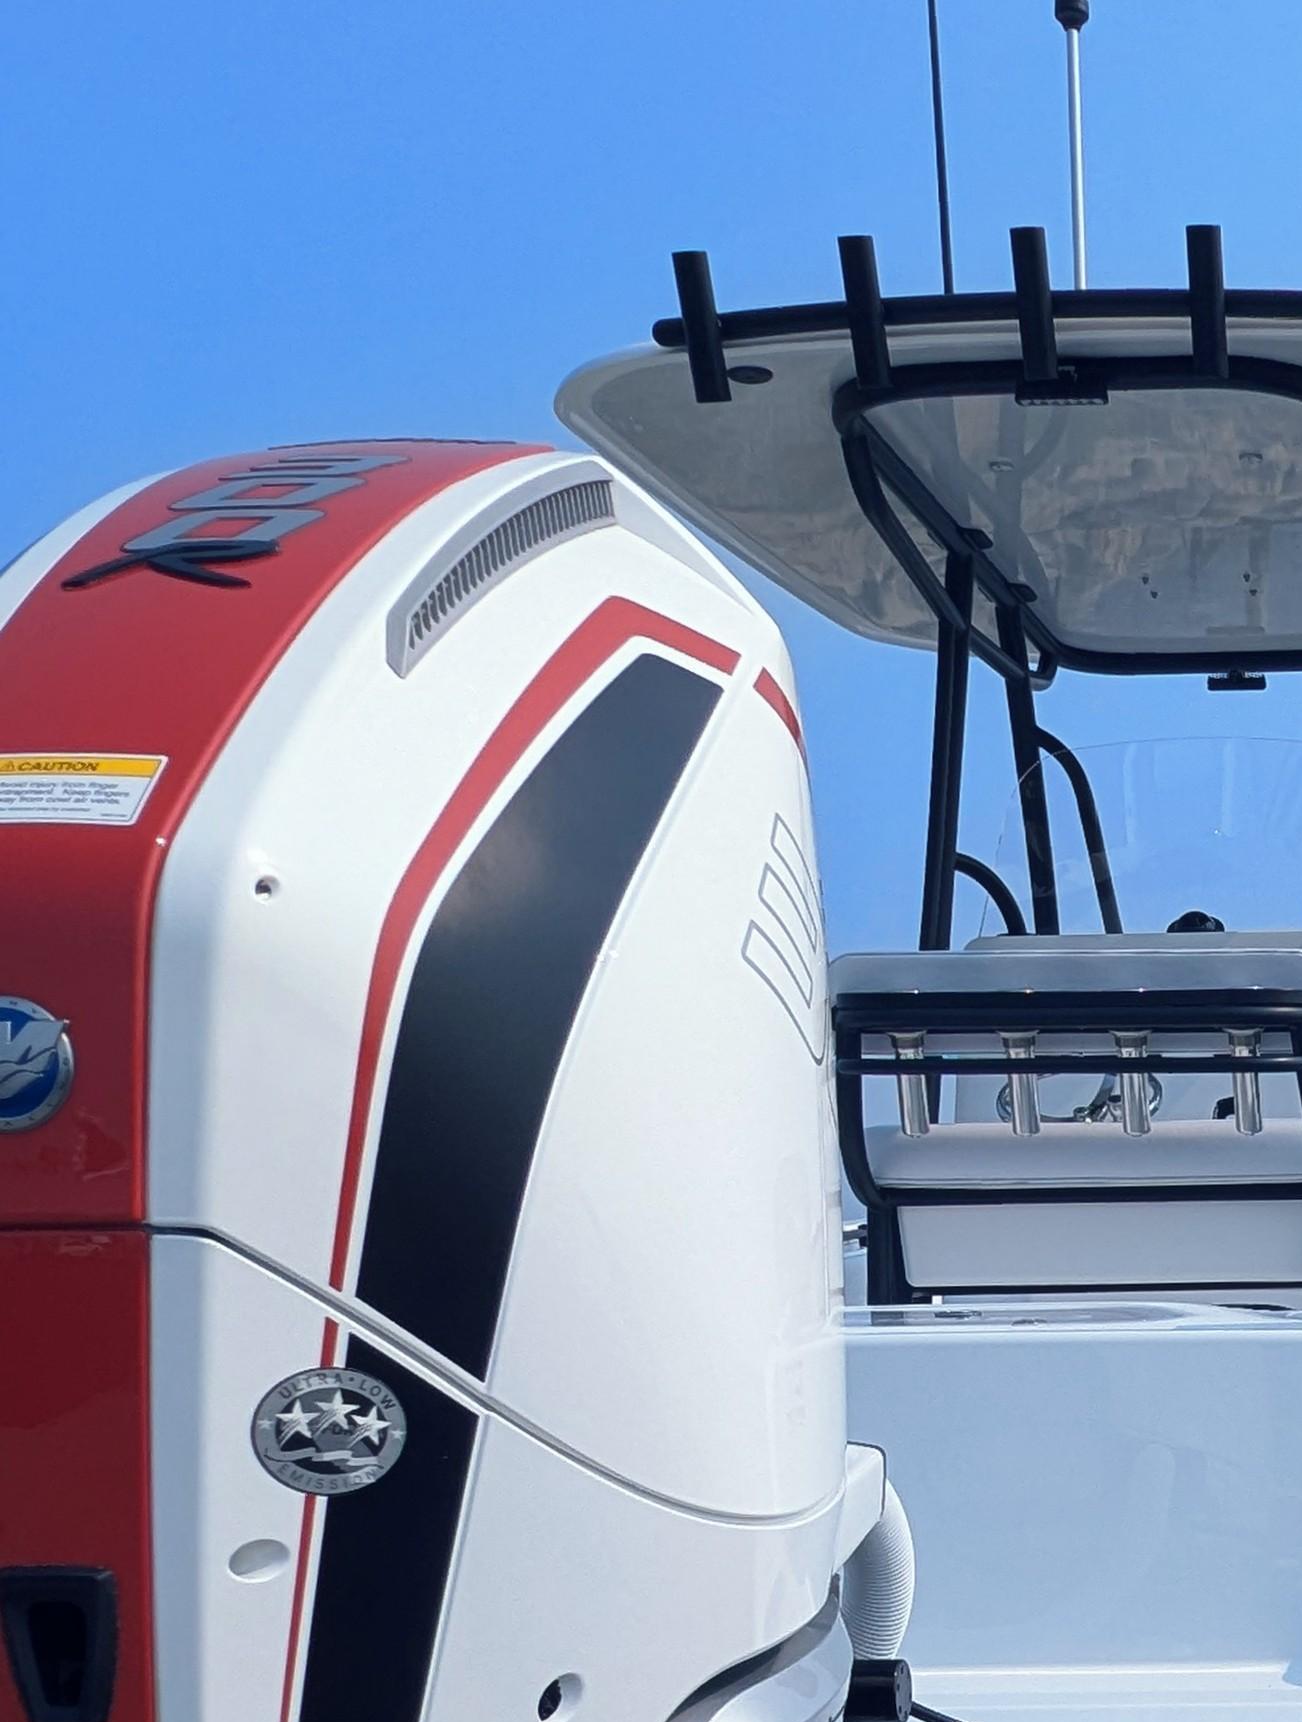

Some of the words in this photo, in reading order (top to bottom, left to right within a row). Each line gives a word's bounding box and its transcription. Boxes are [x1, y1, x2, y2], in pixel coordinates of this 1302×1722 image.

[18, 761, 100, 772] CAUTION
[88, 782, 119, 791] finger
[62, 789, 92, 797] Keep
[93, 790, 131, 798] fingers
[278, 1373, 344, 1400] ULTRA
[359, 1378, 397, 1411] LOW
[277, 1463, 379, 1490] EMISSION
